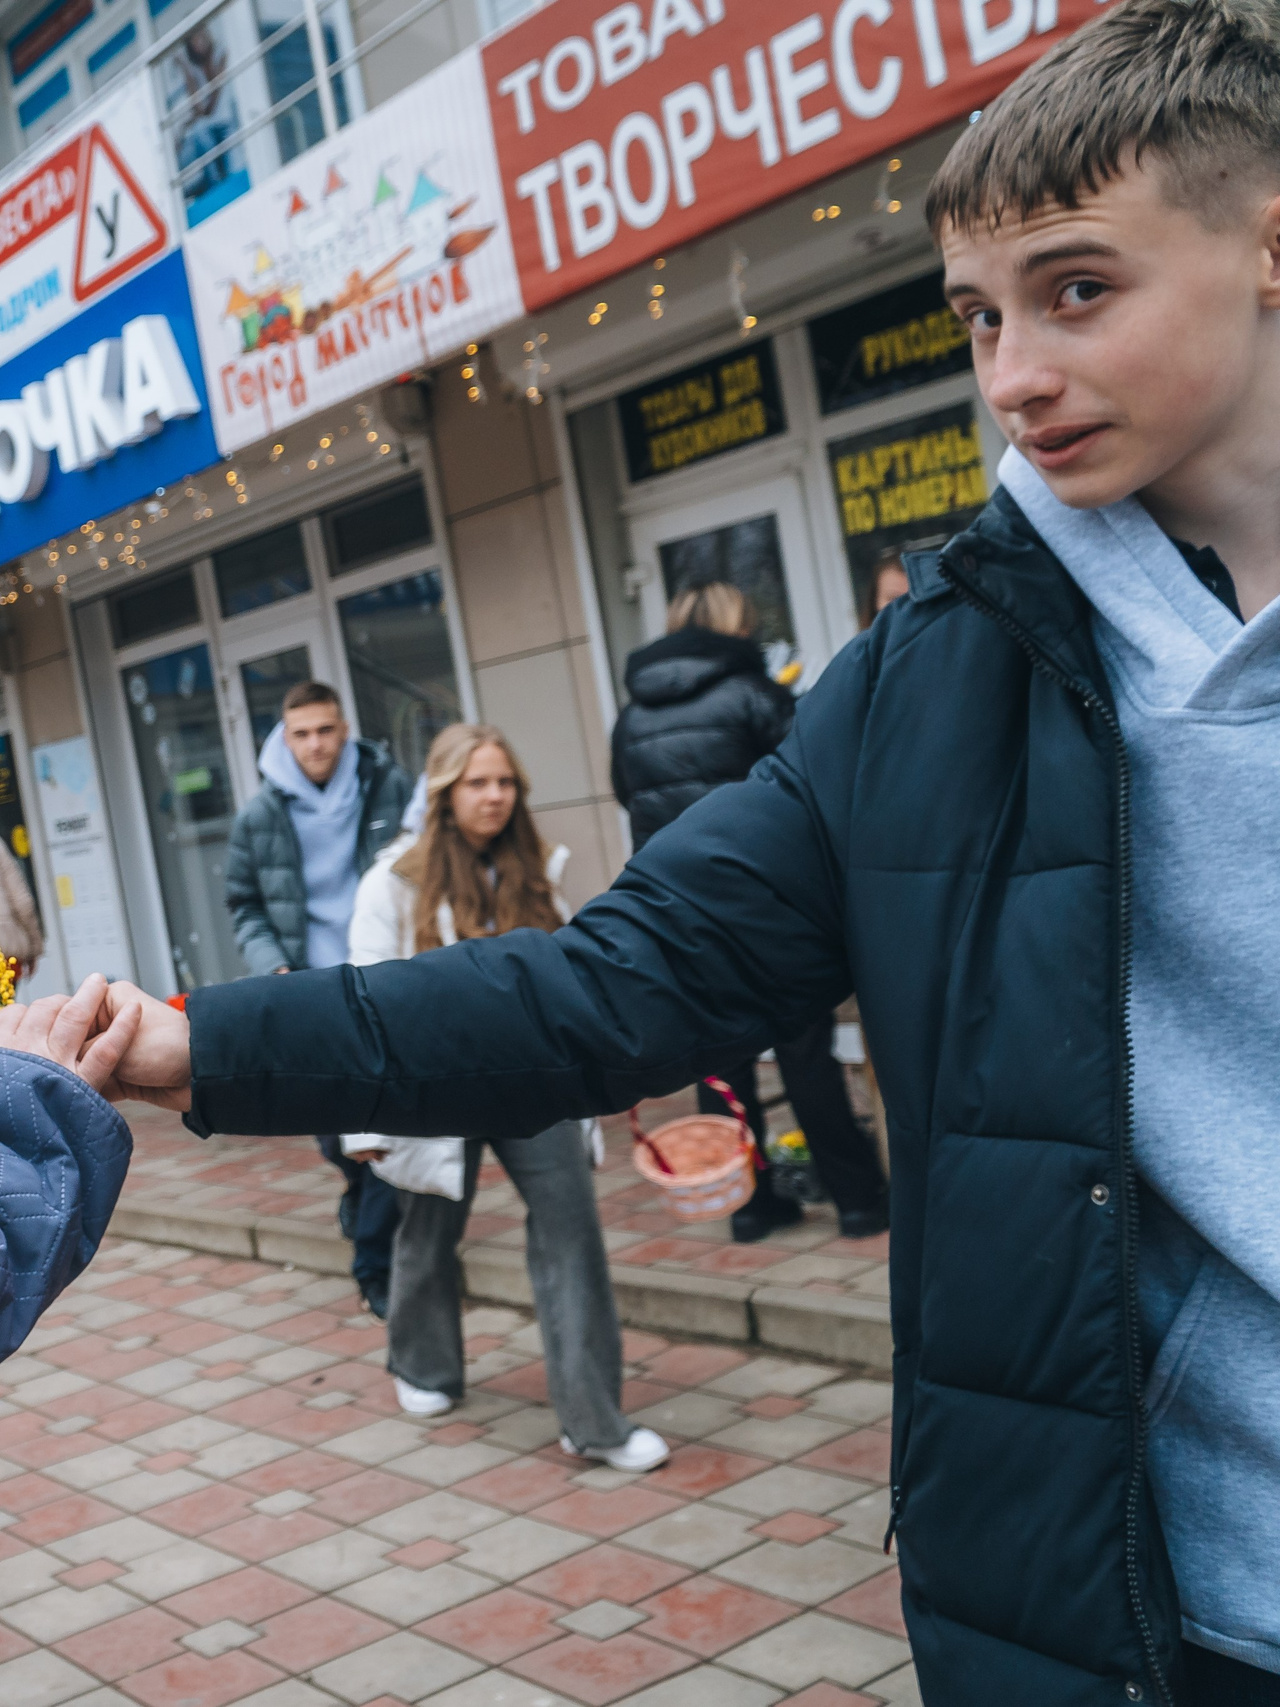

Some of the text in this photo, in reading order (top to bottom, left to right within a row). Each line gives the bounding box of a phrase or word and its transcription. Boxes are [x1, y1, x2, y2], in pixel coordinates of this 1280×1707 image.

[517, 0, 1111, 271] ТВОРЧЕСТВ
[835, 421, 981, 493] КАРТИНЫ
[843, 493, 875, 537] ПО
